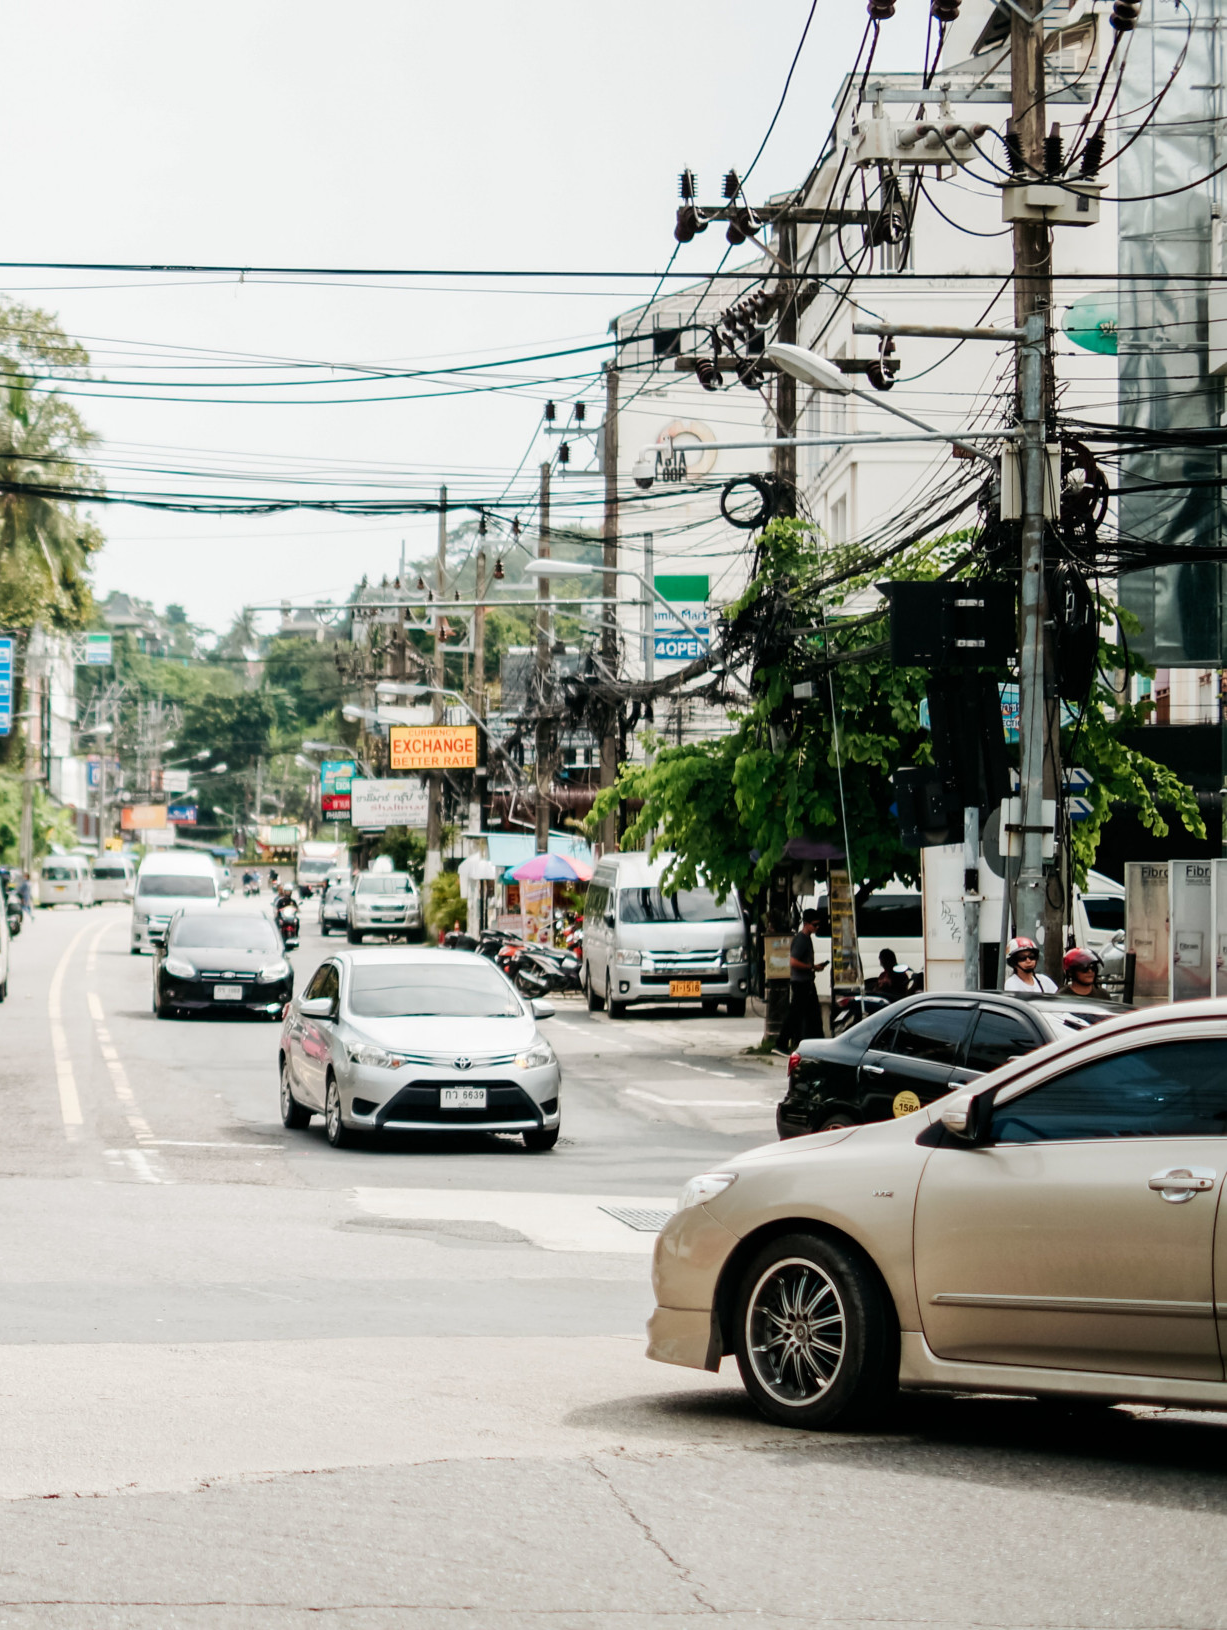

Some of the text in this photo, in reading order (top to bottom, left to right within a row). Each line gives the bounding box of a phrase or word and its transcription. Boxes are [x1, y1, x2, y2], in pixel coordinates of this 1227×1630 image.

[408, 728, 457, 737] CURRENCY
[393, 738, 474, 754] EXCHANGE
[393, 756, 474, 766] BETTER RATE
[462, 1090, 485, 1100] 6639
